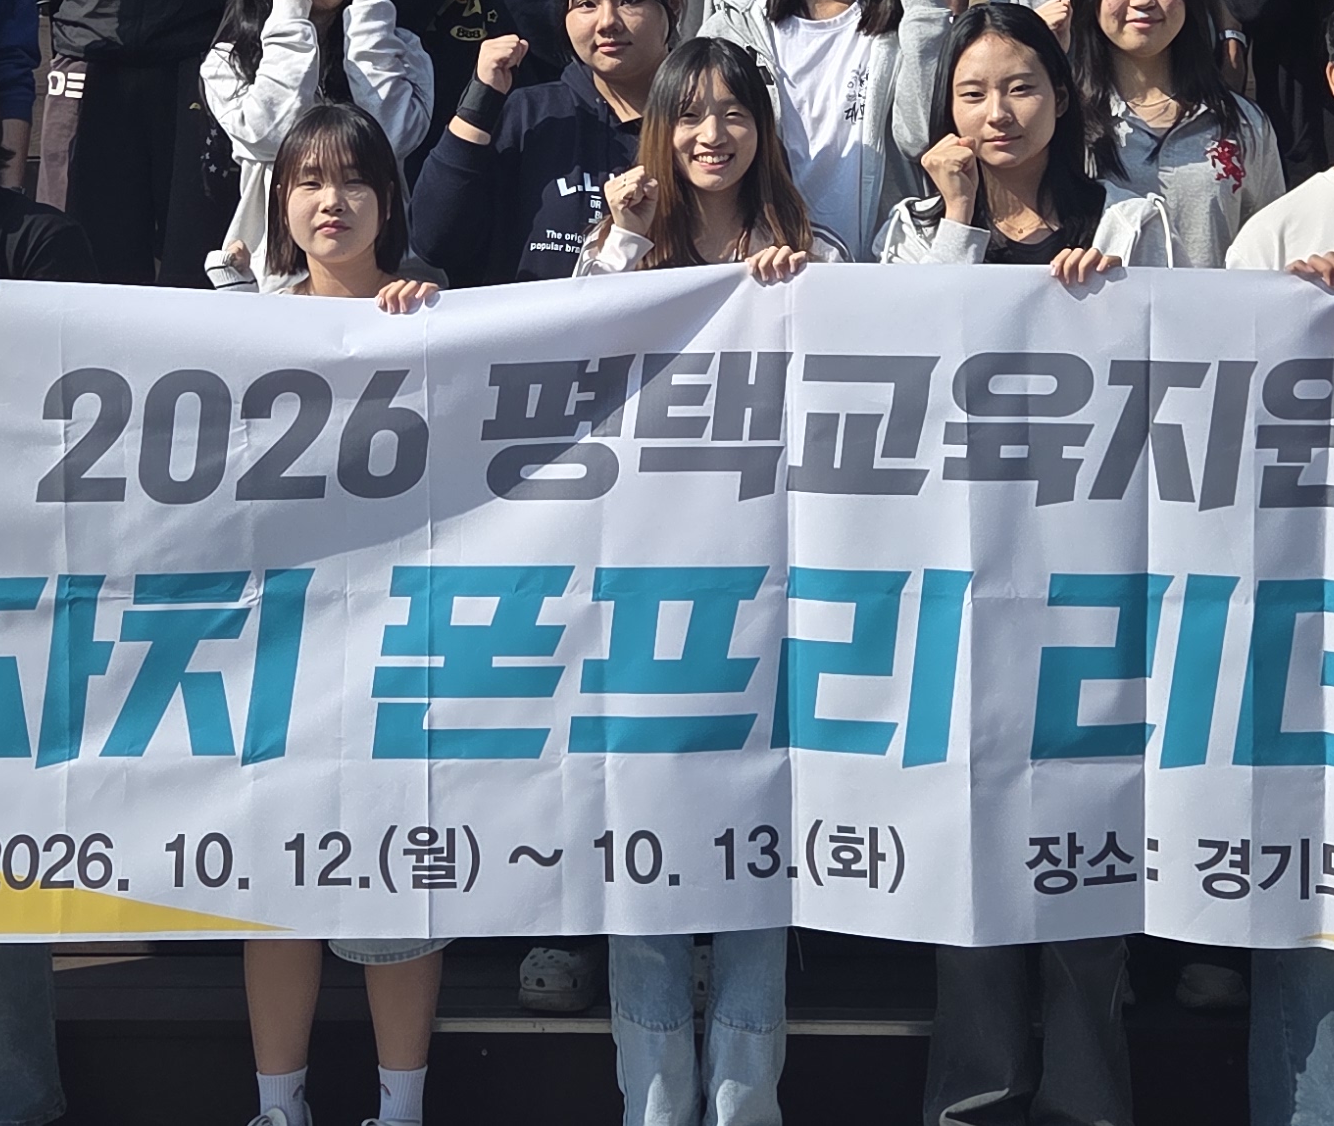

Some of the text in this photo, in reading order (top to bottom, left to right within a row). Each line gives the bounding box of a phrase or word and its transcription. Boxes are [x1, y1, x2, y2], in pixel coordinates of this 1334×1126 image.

[530, 241, 581, 254] popular bra
[546, 229, 587, 244] The origi
[34, 367, 431, 506] 2026
[370, 564, 975, 770] 폰프리
[164, 832, 250, 891] 10.
[283, 824, 482, 894] 12.(월)
[593, 829, 681, 887] 10.
[713, 818, 907, 894] 13.(화)
[1024, 830, 1160, 894] 장소:
